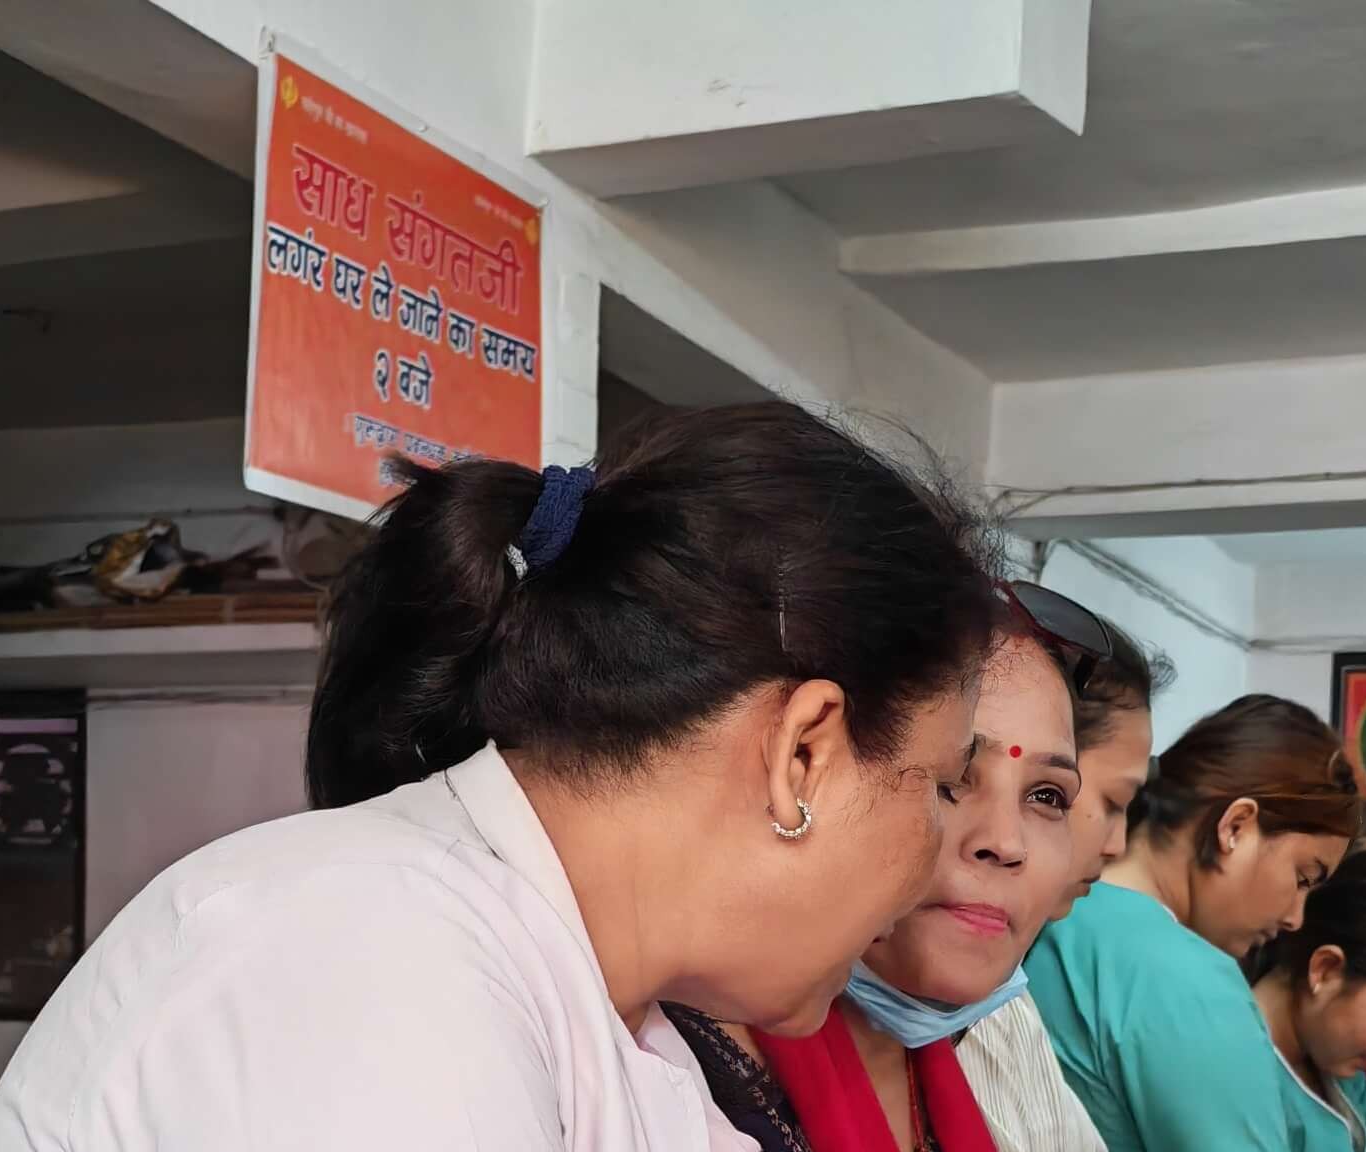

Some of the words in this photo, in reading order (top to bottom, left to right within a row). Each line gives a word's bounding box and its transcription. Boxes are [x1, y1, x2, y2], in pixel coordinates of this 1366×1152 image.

[292, 145, 374, 241] साध
[386, 192, 523, 316] संगतजी
[332, 255, 368, 310] घर
[371, 262, 395, 322] ले
[398, 286, 443, 344] जाने
[447, 311, 476, 358] का
[480, 326, 537, 381] समय
[397, 352, 433, 406] बजे
